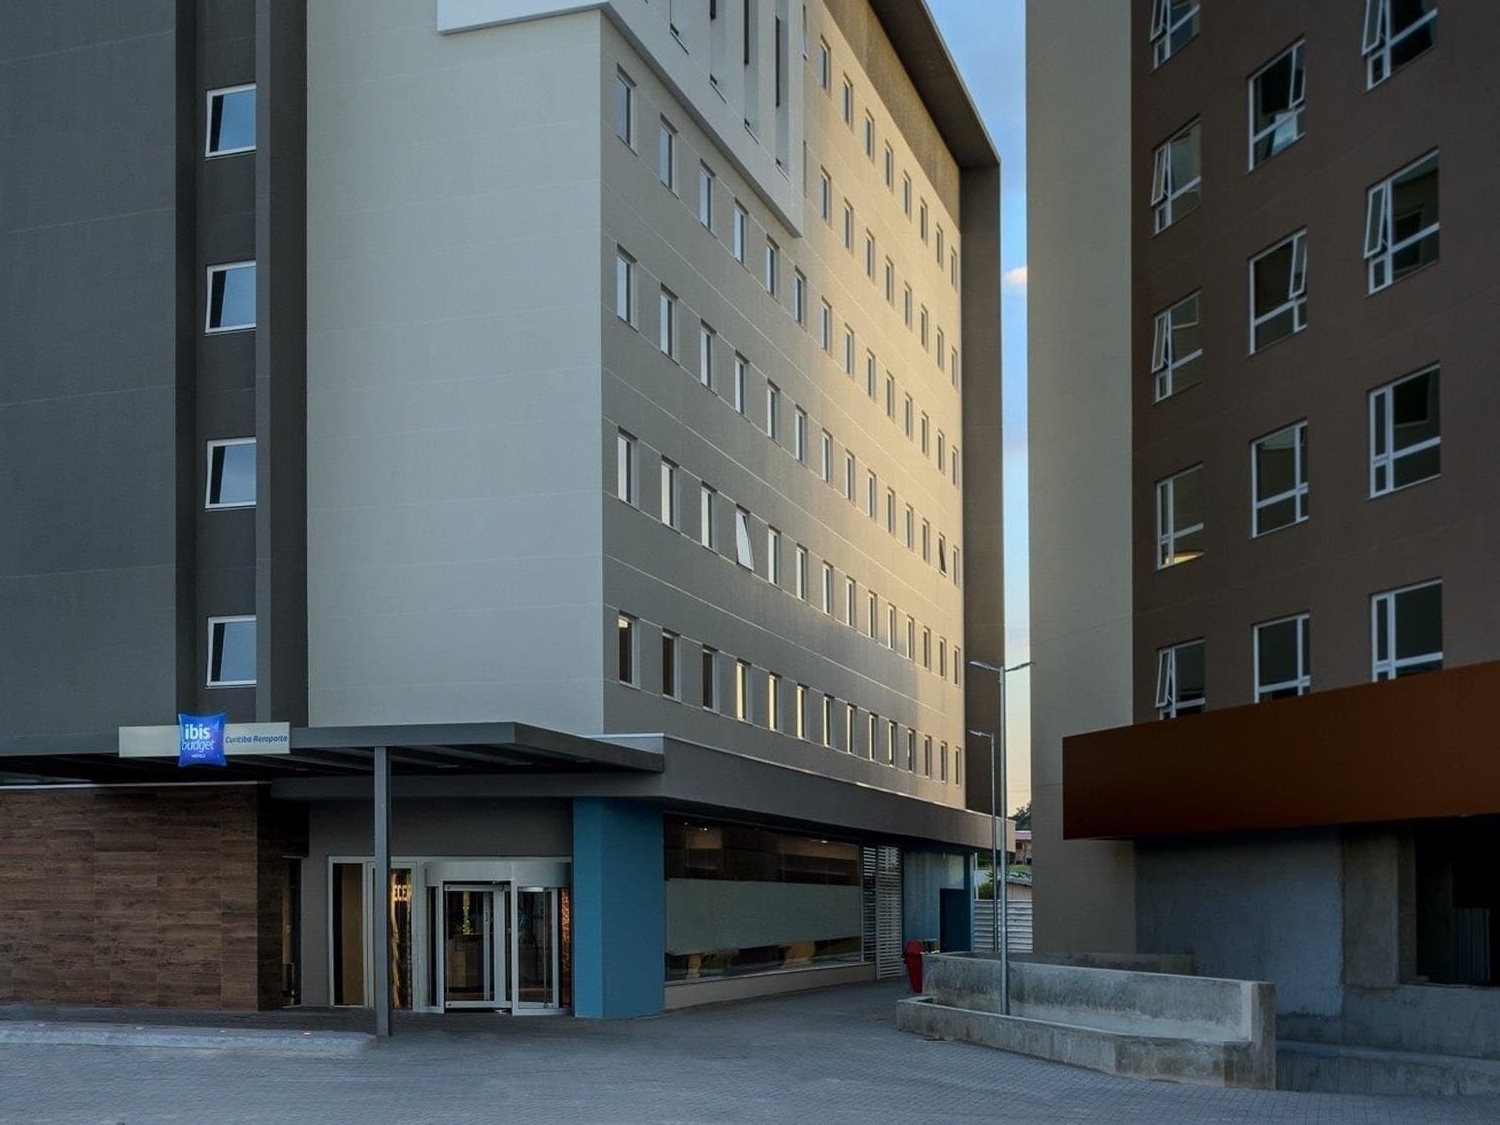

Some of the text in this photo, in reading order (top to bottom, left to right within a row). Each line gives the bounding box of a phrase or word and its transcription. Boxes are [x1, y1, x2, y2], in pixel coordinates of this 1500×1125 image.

[185, 723, 211, 740] ibis
[181, 739, 215, 753] budget
[225, 734, 288, 744] Curitiba Aeroporto
